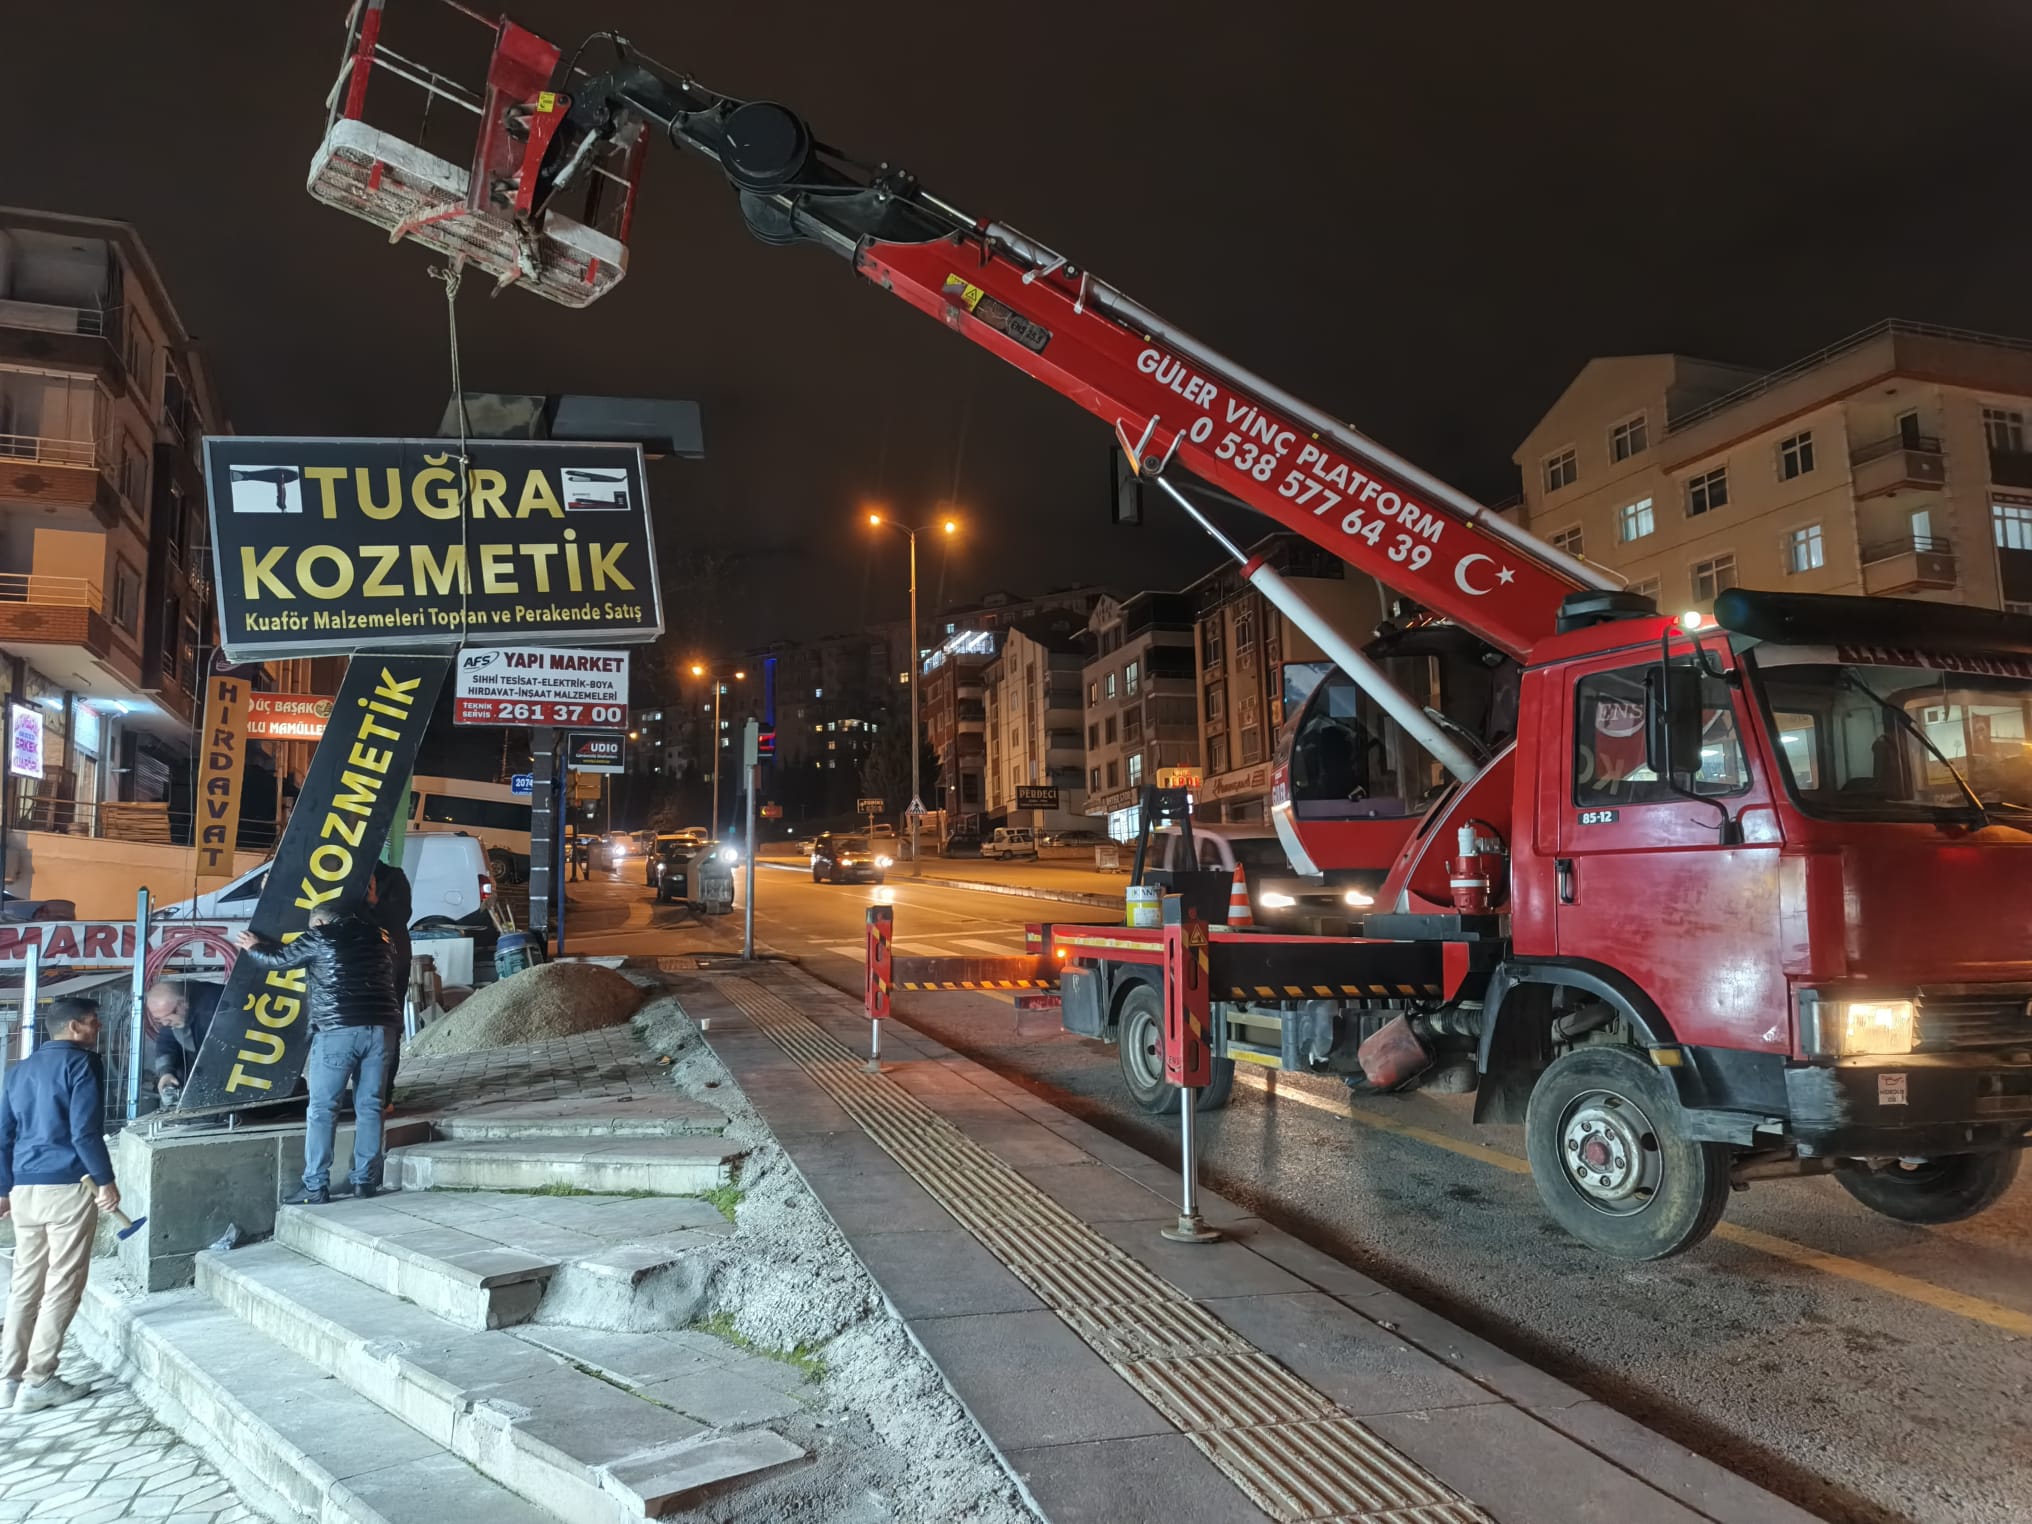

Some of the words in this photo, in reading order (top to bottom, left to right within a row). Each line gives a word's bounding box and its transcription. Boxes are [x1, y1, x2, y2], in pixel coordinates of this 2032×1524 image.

[1137, 349, 1218, 410] GÜLER
[1225, 397, 1297, 459] VİNÇ
[1296, 443, 1446, 544] PLATFORM
[304, 454, 566, 521] TUĞRA
[1189, 416, 1214, 443] 0
[1214, 432, 1277, 482] 538
[1277, 469, 1343, 516] 577
[1341, 508, 1386, 547] 64
[1387, 534, 1433, 572] 39
[240, 528, 636, 600] KOZMETİK
[245, 610, 309, 632] Kuaför
[313, 607, 425, 629] Malzemeleri
[428, 607, 487, 630] Toptan
[491, 610, 512, 623] ve
[515, 602, 601, 623] Perakende
[604, 602, 642, 623] Satış
[463, 655, 491, 668] AFS
[503, 651, 544, 669] YAPI
[550, 654, 625, 673] MARKET
[472, 674, 499, 685] SIHHİ
[500, 675, 614, 690] TESİSAT-ELEKTRİK-BOYA
[468, 686, 552, 699] HIRDAVAT-İNŞAAT
[553, 690, 617, 702] MALZEMELERİ
[255, 698, 271, 715] ÜÇ
[275, 701, 314, 716] BAŞAK
[462, 709, 491, 719] SERVİS
[463, 702, 493, 711] TEKNİK
[498, 703, 545, 720] 261
[553, 705, 584, 722] 37
[591, 707, 622, 723] 00
[1599, 701, 1644, 722] ENS
[270, 720, 327, 736] MAMÜLLE
[577, 741, 619, 754] AUDIO
[203, 680, 238, 867] HIRDAVAT
[1582, 811, 1612, 824] 85-12
[225, 931, 307, 1093] TUĞR
[294, 666, 422, 911] KOZMETİK
